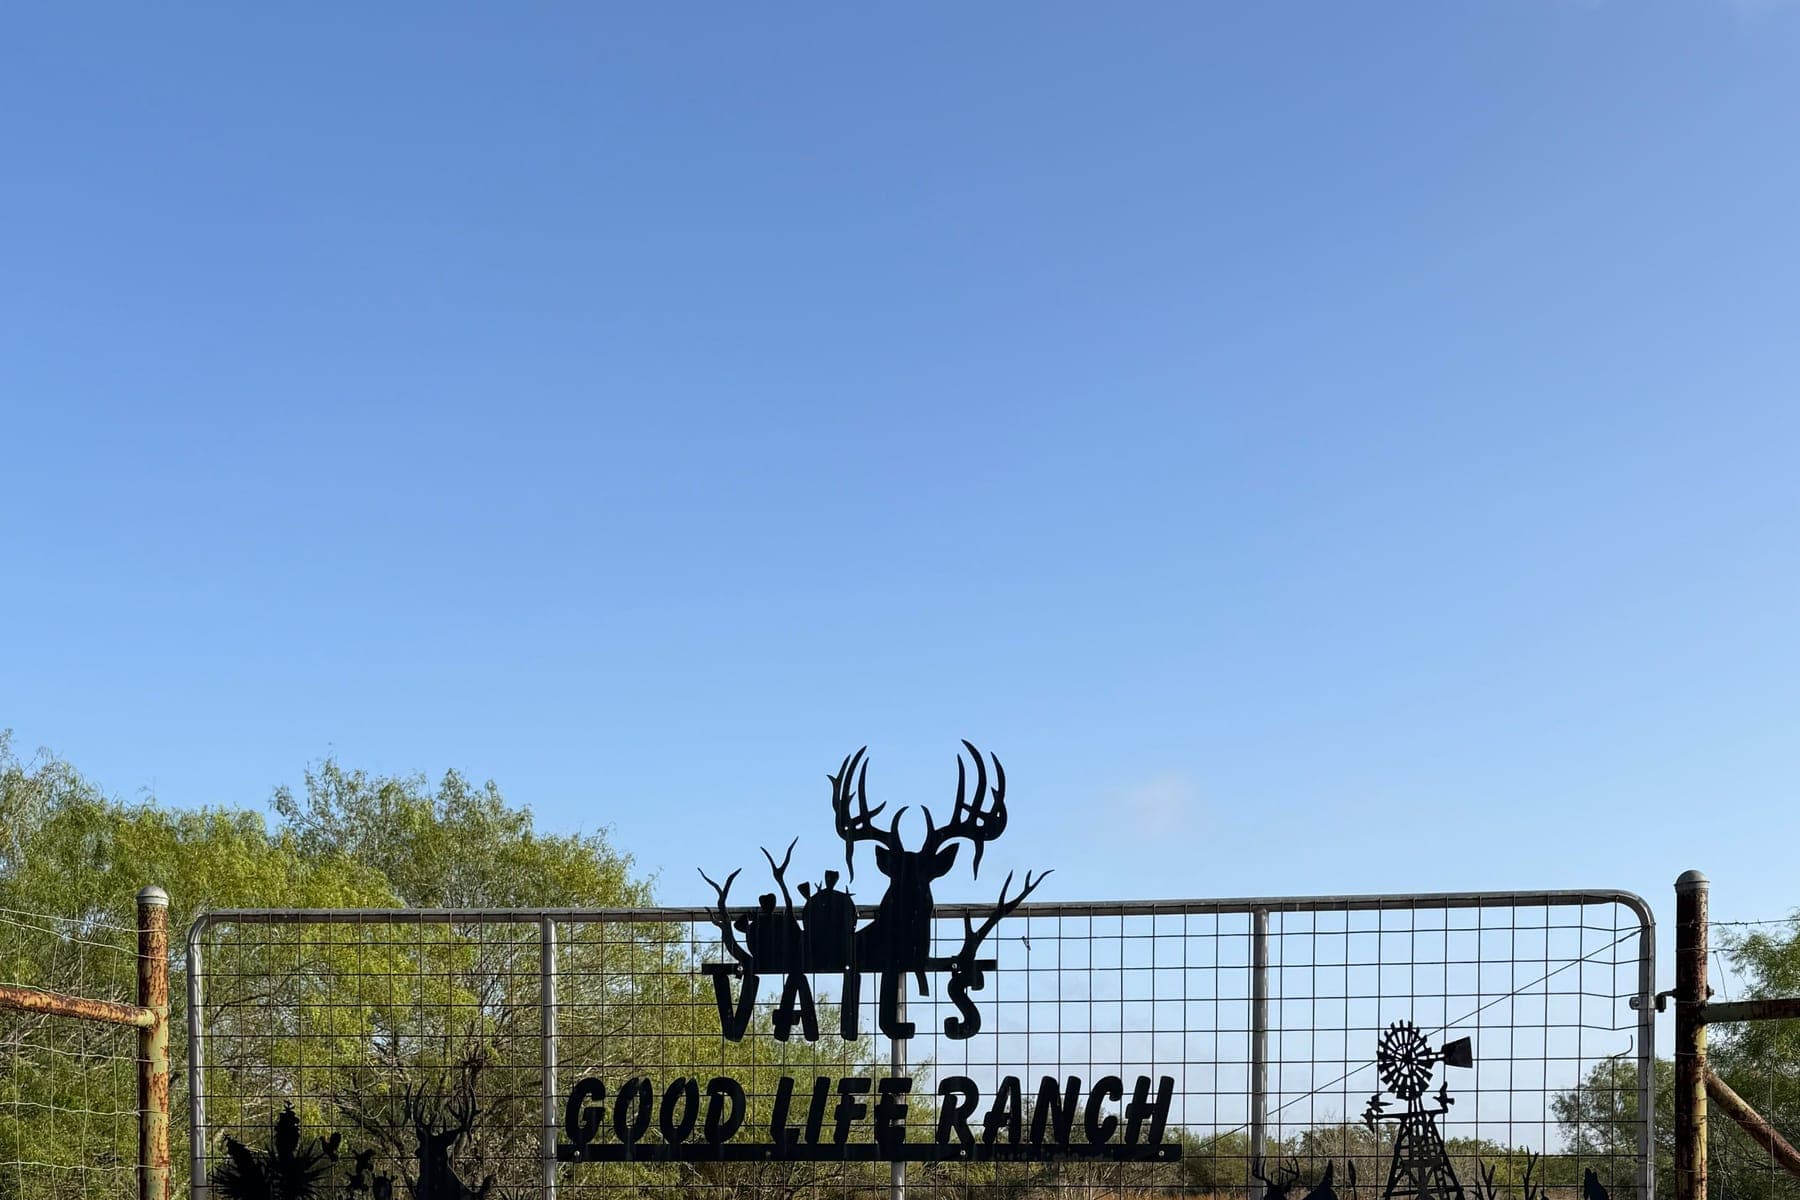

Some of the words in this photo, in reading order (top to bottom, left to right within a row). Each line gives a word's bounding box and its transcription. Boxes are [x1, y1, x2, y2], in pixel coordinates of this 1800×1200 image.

[712, 966, 984, 1042] VAIL'S
[565, 1076, 746, 1145] GOOD
[770, 1076, 913, 1145] LIFE
[935, 1075, 1175, 1145] RANCH
